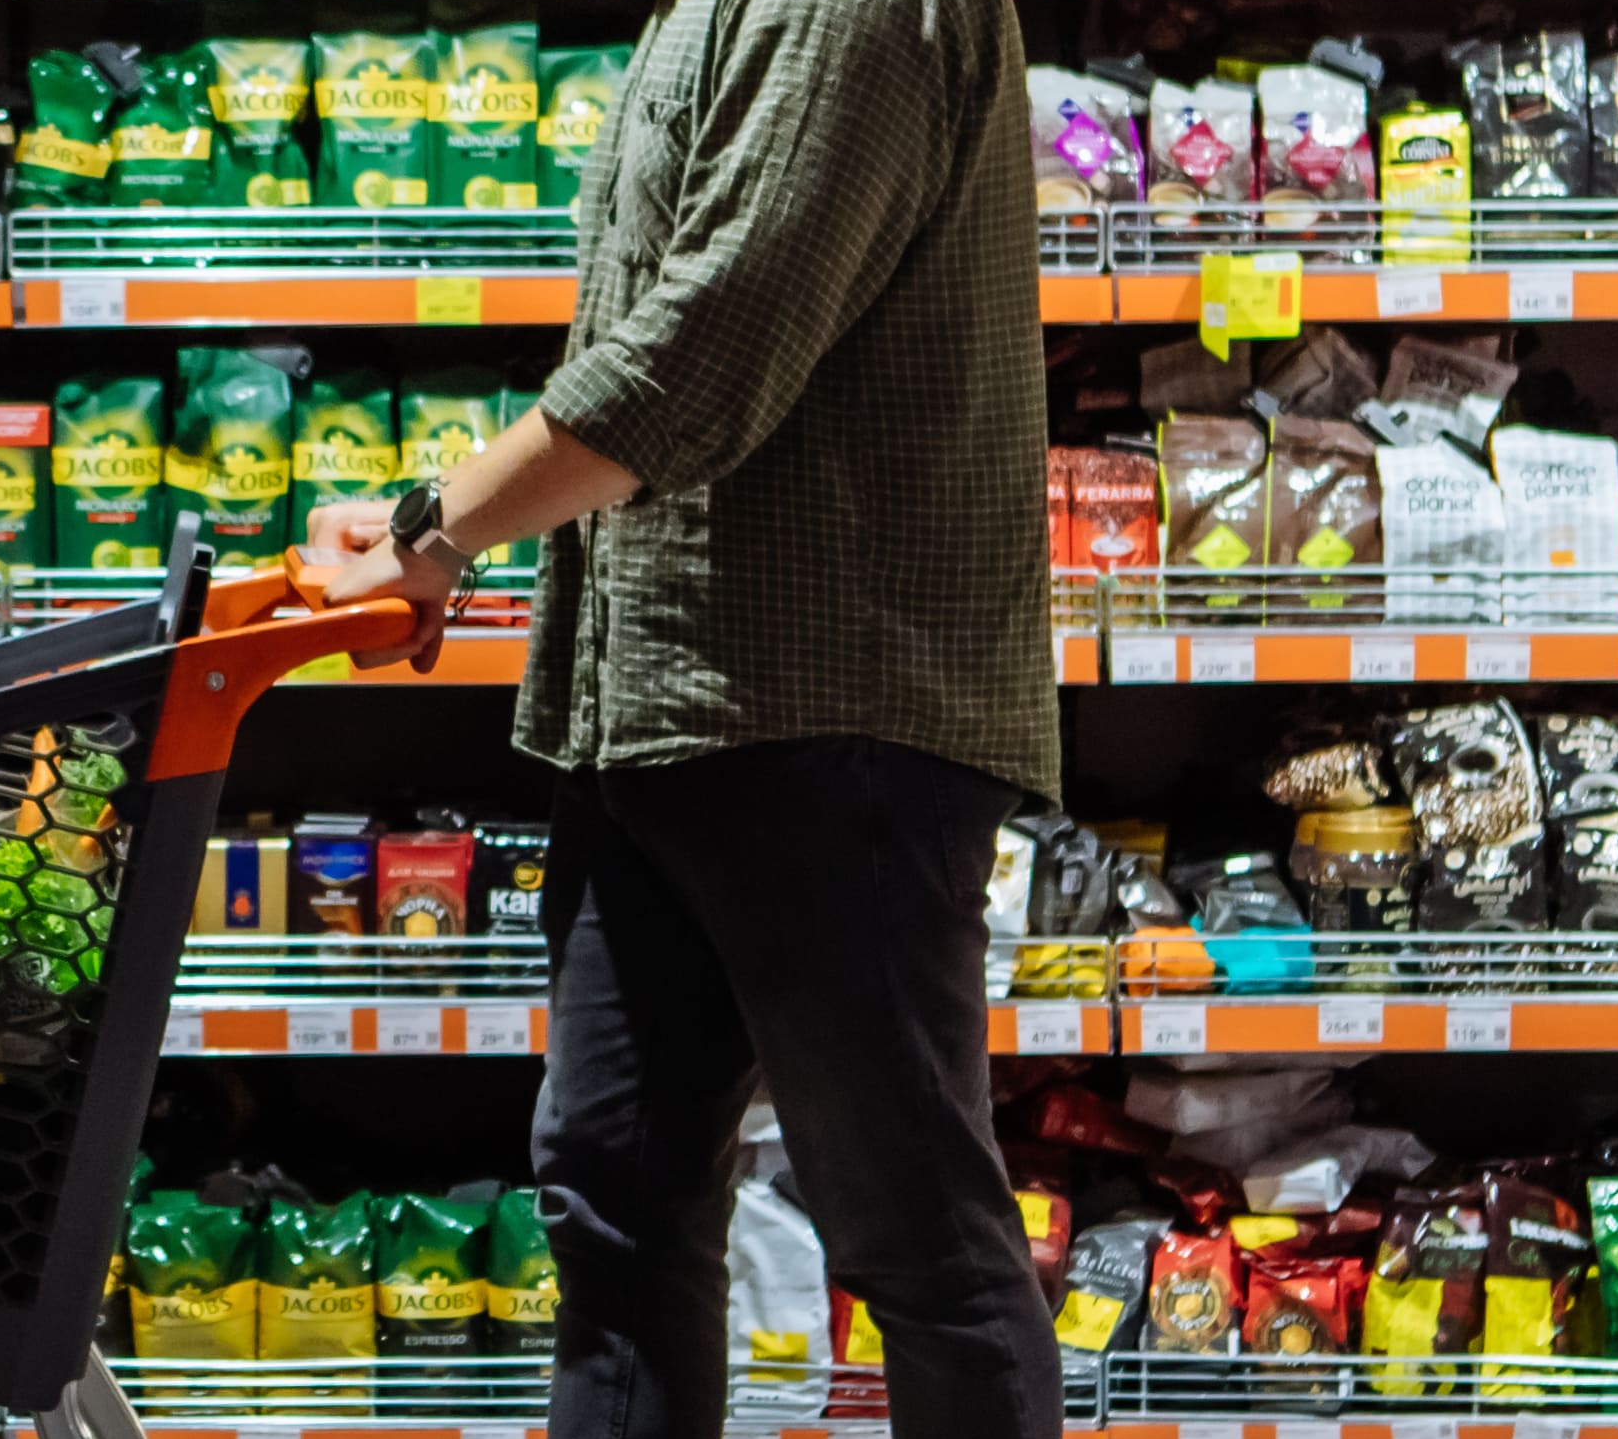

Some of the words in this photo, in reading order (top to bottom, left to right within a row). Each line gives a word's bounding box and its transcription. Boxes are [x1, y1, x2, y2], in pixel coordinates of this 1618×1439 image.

[324, 87, 424, 111] JACOBS
[437, 91, 533, 115] JACOBS
[337, 130, 412, 147] MONARCH
[550, 120, 602, 141] JACO
[63, 456, 160, 480] JACOBS
[410, 446, 475, 468] JACO
[1075, 484, 1154, 502] FERARRA
[1405, 473, 1481, 496] coffee
[1407, 491, 1477, 515] planet
[279, 1294, 365, 1318] JACOBS
[388, 1290, 476, 1314] JACOBS
[507, 1296, 558, 1318] JAC
